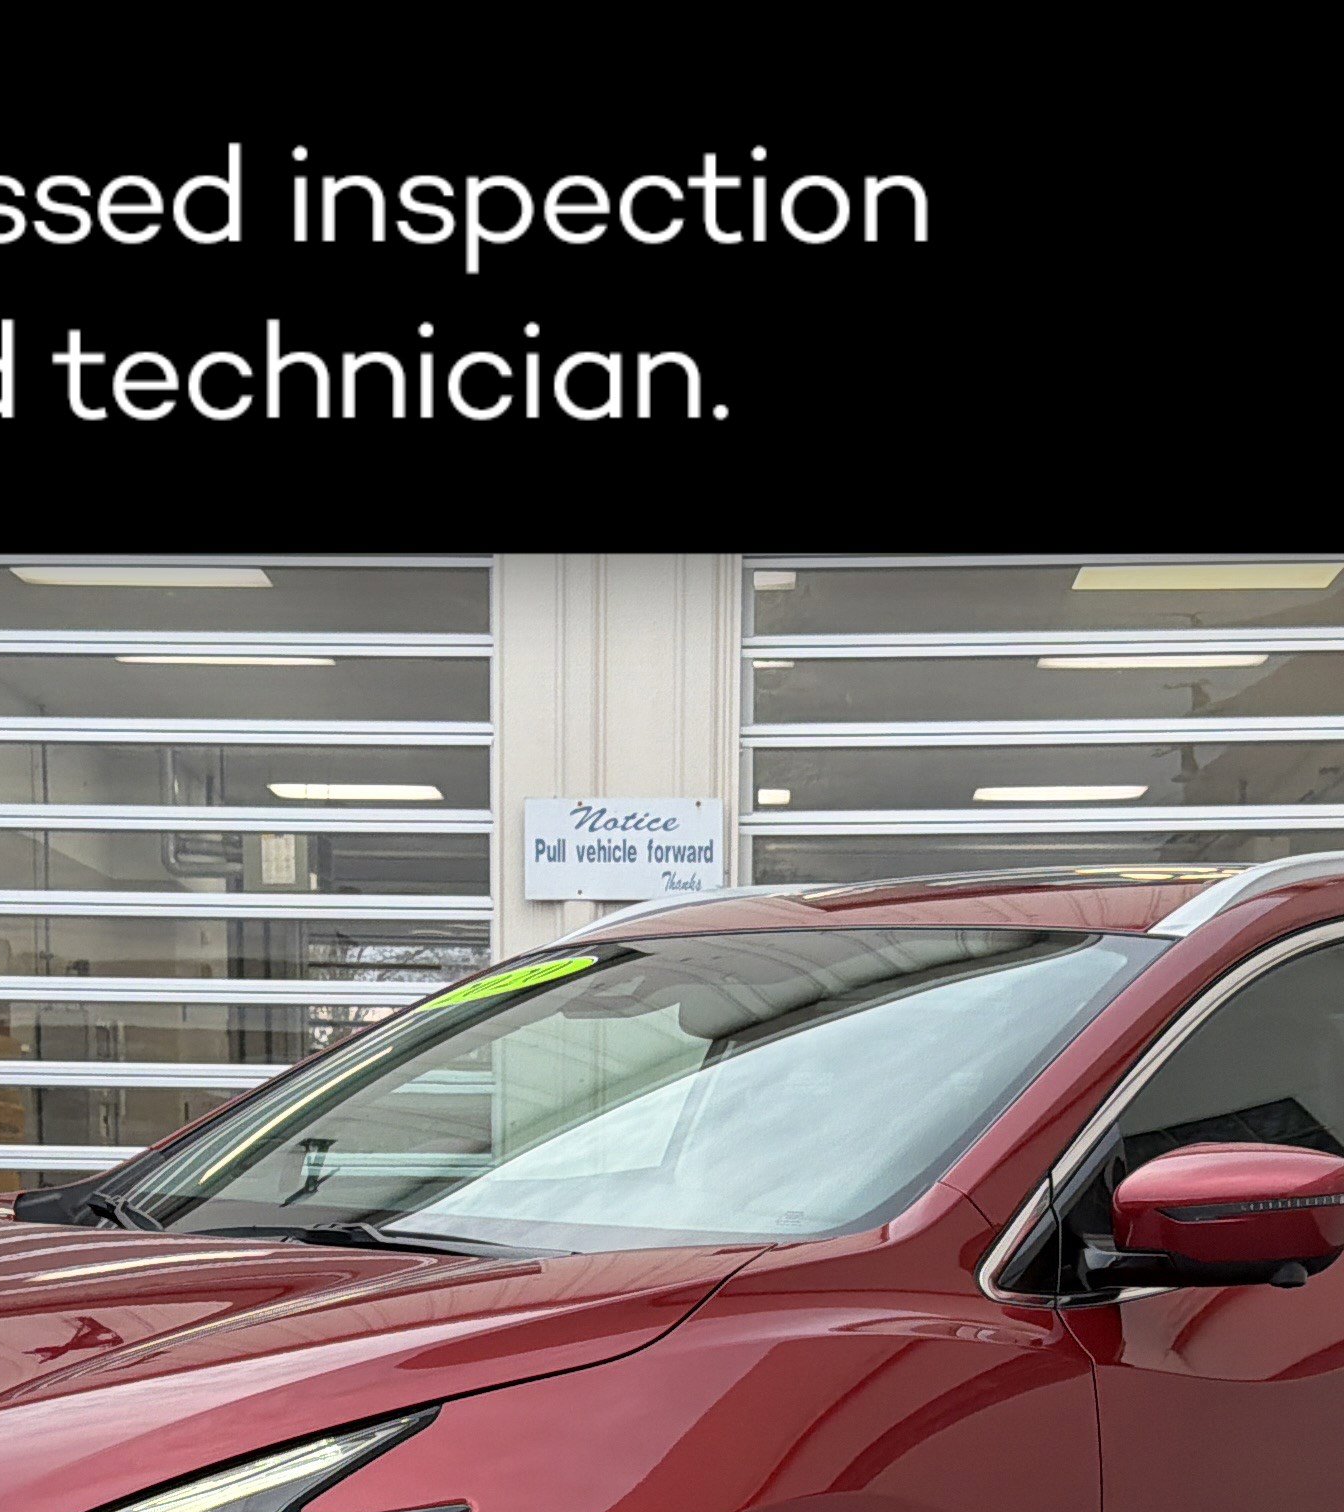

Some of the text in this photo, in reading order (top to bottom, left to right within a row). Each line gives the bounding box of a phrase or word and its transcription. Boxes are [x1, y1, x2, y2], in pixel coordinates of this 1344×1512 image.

[570, 805, 679, 832] Notice
[534, 838, 714, 863] Pull vehicle forward
[661, 871, 702, 892] Thanks
